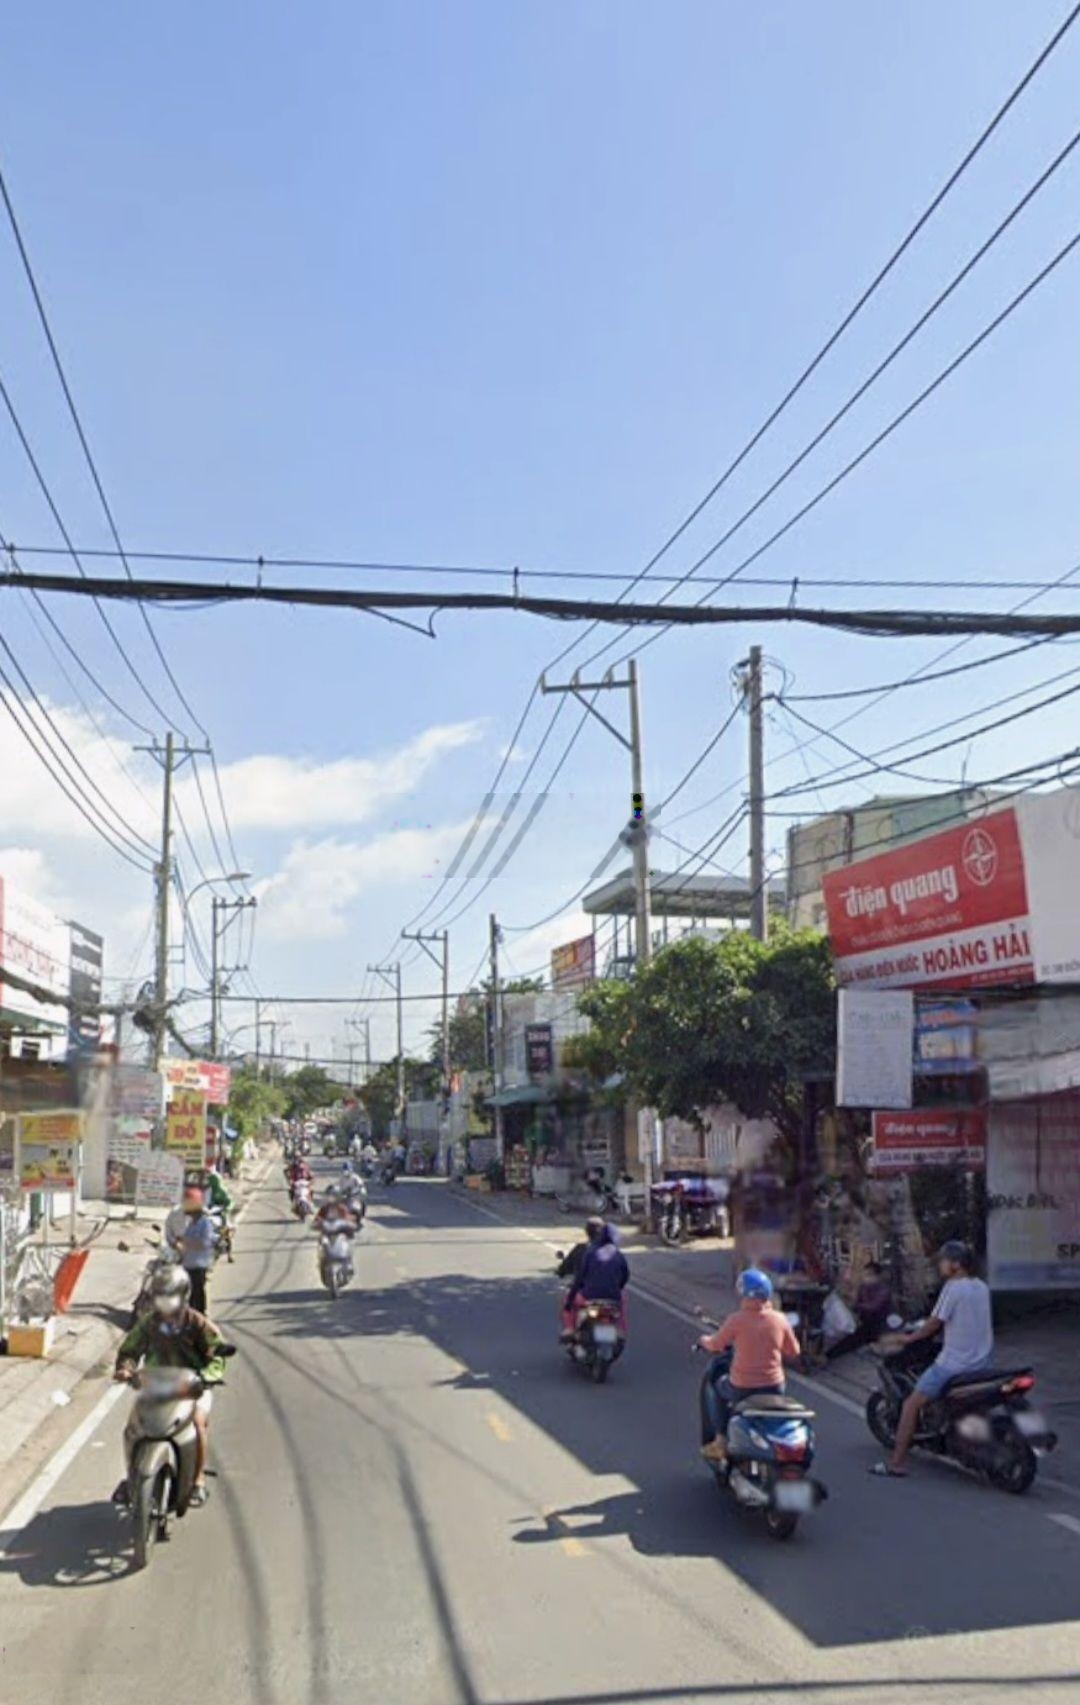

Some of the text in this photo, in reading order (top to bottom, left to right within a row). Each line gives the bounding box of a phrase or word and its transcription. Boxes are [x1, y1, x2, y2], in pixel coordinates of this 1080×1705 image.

[839, 864, 960, 919] điện quang
[922, 939, 989, 974] HOÀNG
[992, 924, 1031, 961] HẢI
